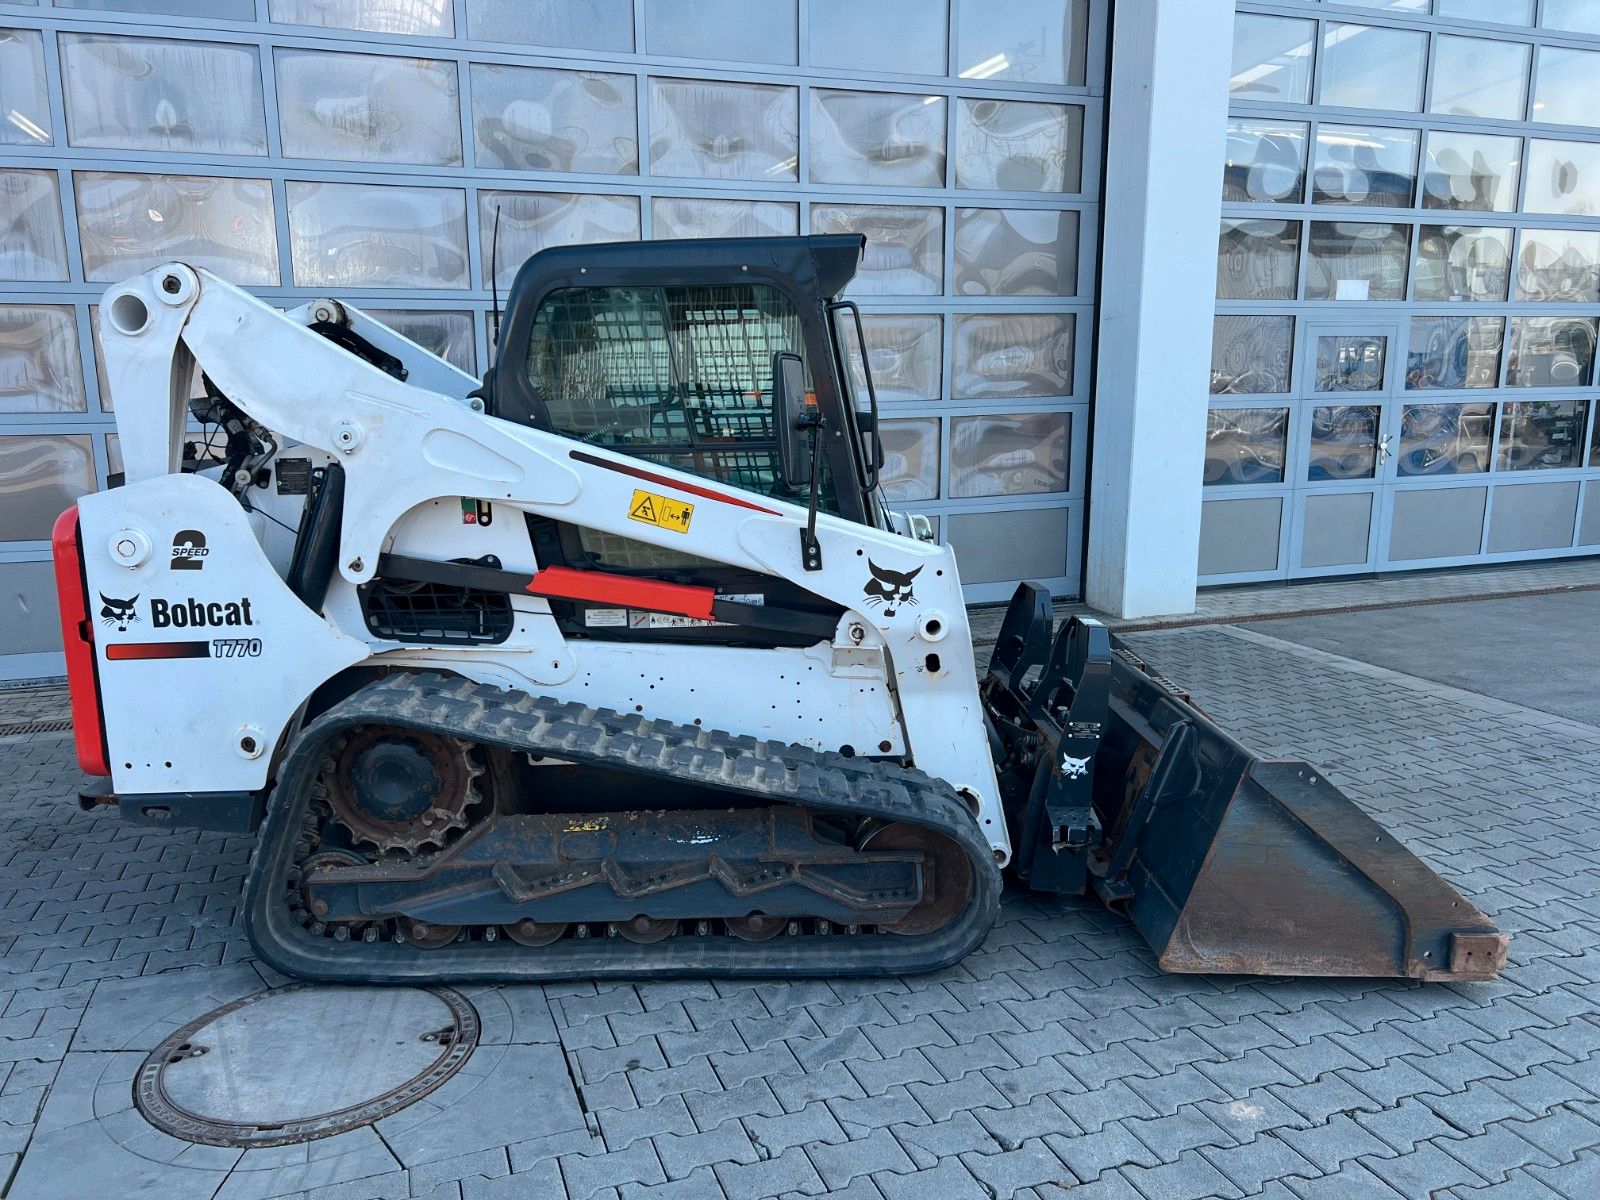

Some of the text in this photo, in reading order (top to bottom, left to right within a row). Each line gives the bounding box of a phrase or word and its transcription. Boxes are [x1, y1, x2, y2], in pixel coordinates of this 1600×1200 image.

[170, 529, 207, 570] 2
[171, 548, 210, 556] SPEED
[150, 598, 253, 628] Bobcat
[213, 638, 263, 658] T770
